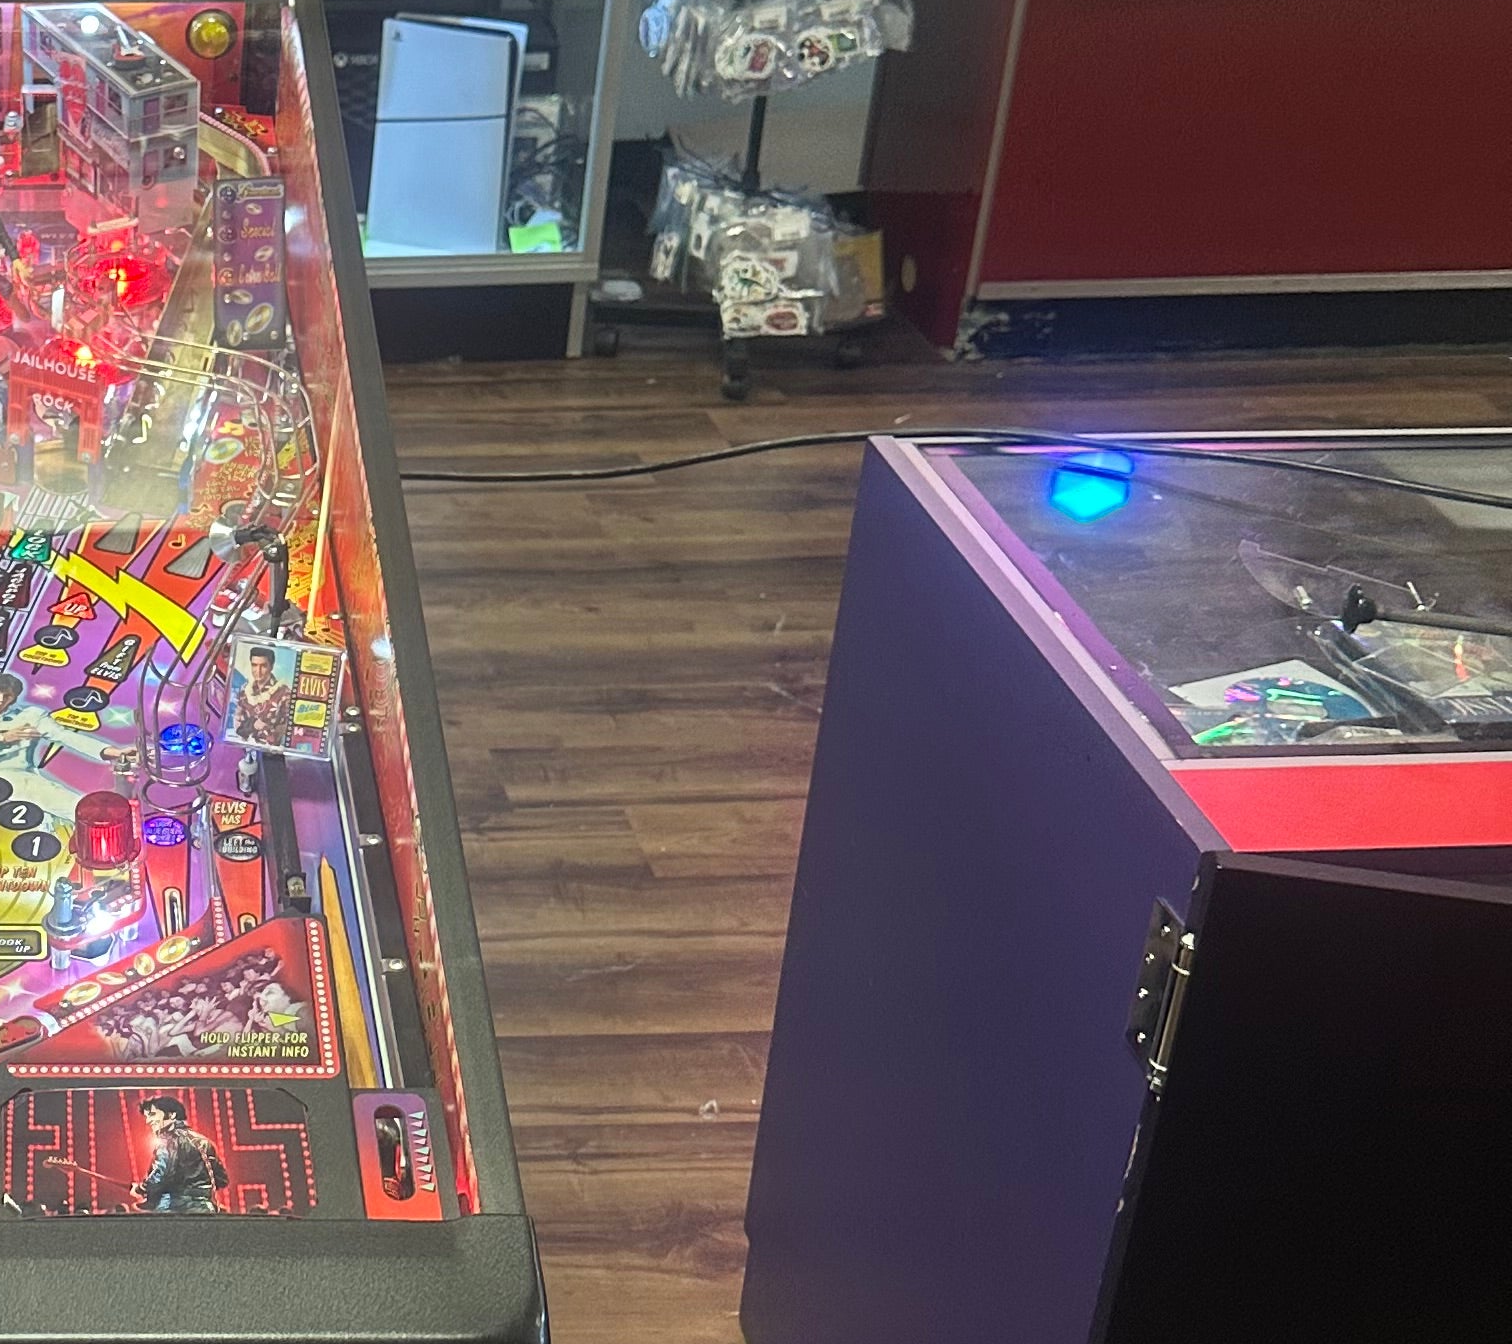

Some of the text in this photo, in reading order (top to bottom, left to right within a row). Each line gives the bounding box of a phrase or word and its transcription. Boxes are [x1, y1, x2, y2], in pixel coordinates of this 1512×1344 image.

[12, 350, 97, 384] JAILHOUSE
[32, 393, 74, 414] ROCK
[64, 603, 88, 615] UP
[299, 675, 328, 697] ELVIS
[213, 801, 247, 815] ELVIS
[12, 806, 27, 824] 2
[221, 814, 242, 826] HAS
[31, 836, 41, 855] 1
[224, 838, 245, 847] LEFT
[12, 865, 38, 878] TEN
[15, 945, 31, 953] UP
[200, 1031, 308, 1044] HOLD FLIPPER FOR
[227, 1045, 310, 1058] INSTANT INFO
